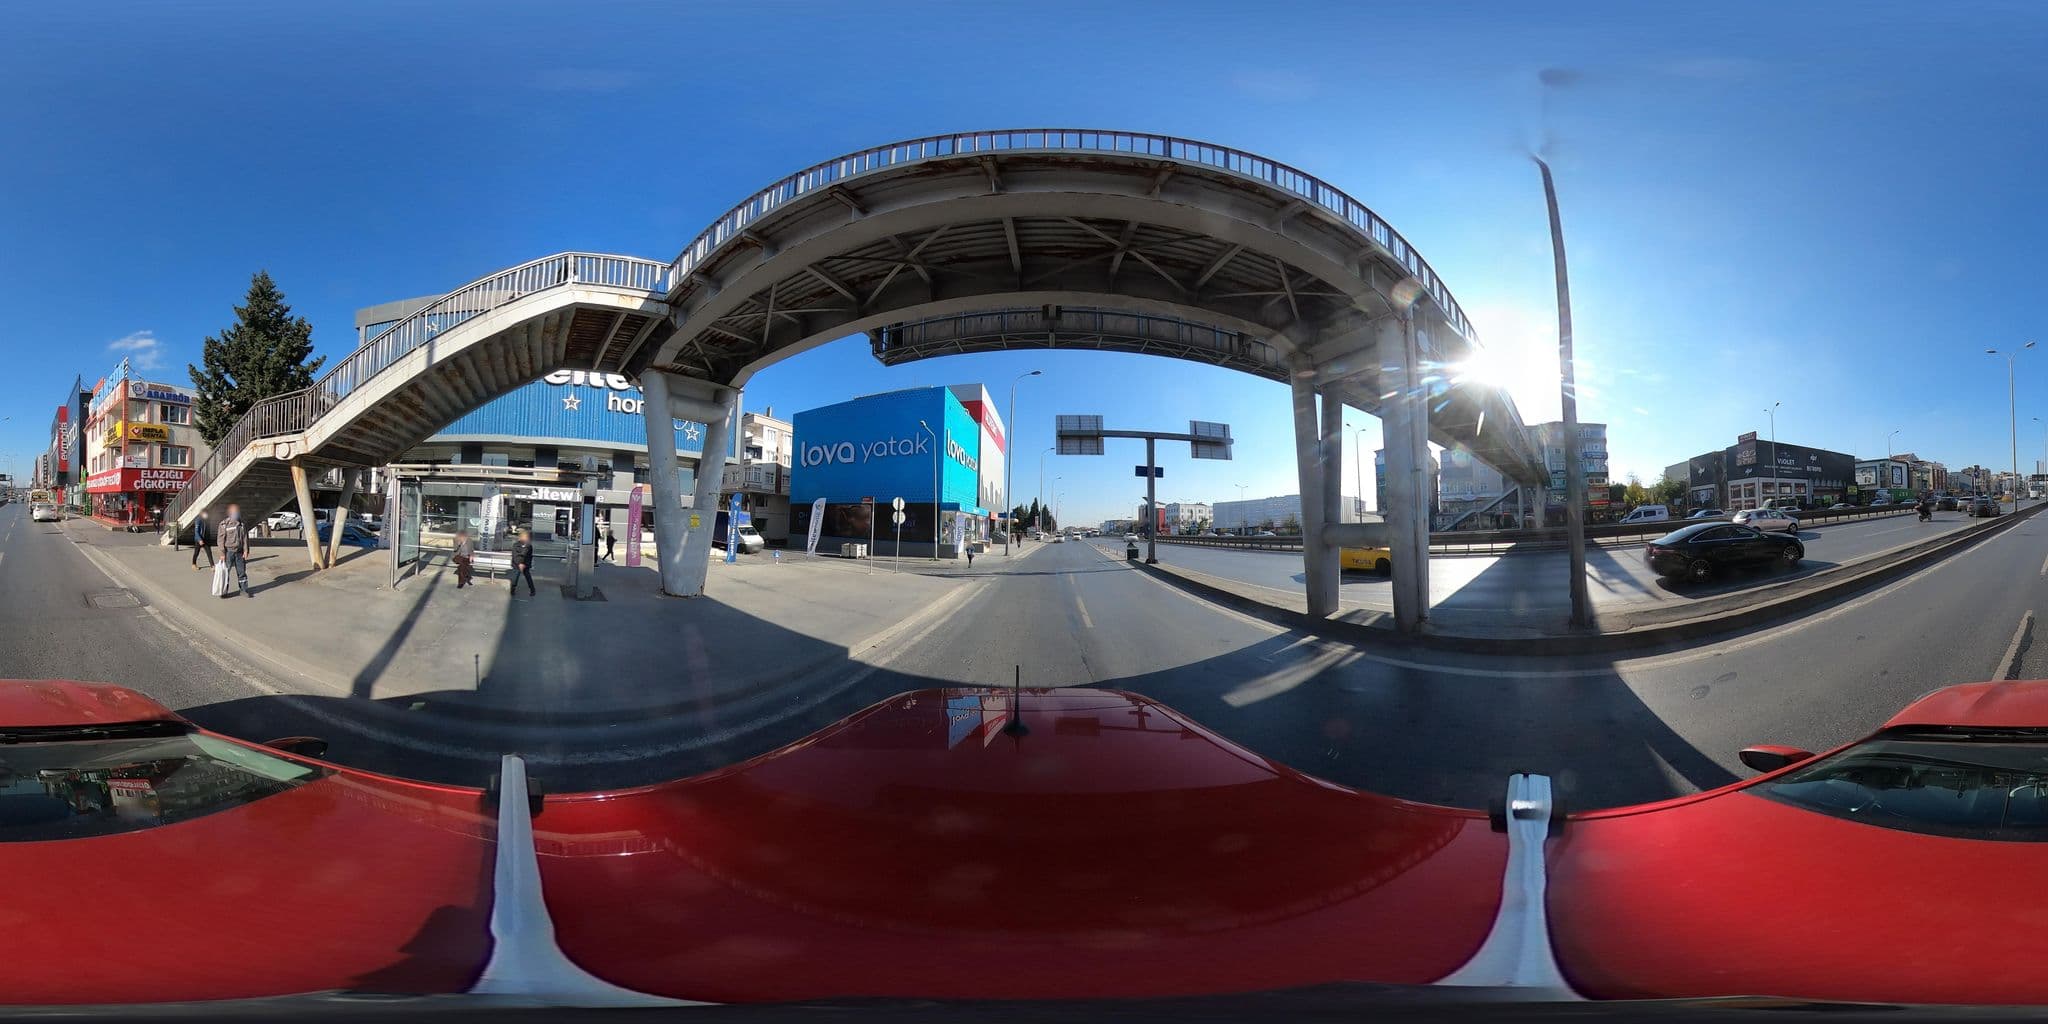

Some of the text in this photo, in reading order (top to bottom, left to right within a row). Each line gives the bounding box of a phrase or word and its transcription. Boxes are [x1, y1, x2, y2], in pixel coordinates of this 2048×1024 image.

[59, 422, 68, 461] evmoda
[800, 432, 928, 468] lova yatak
[946, 429, 967, 466] lova
